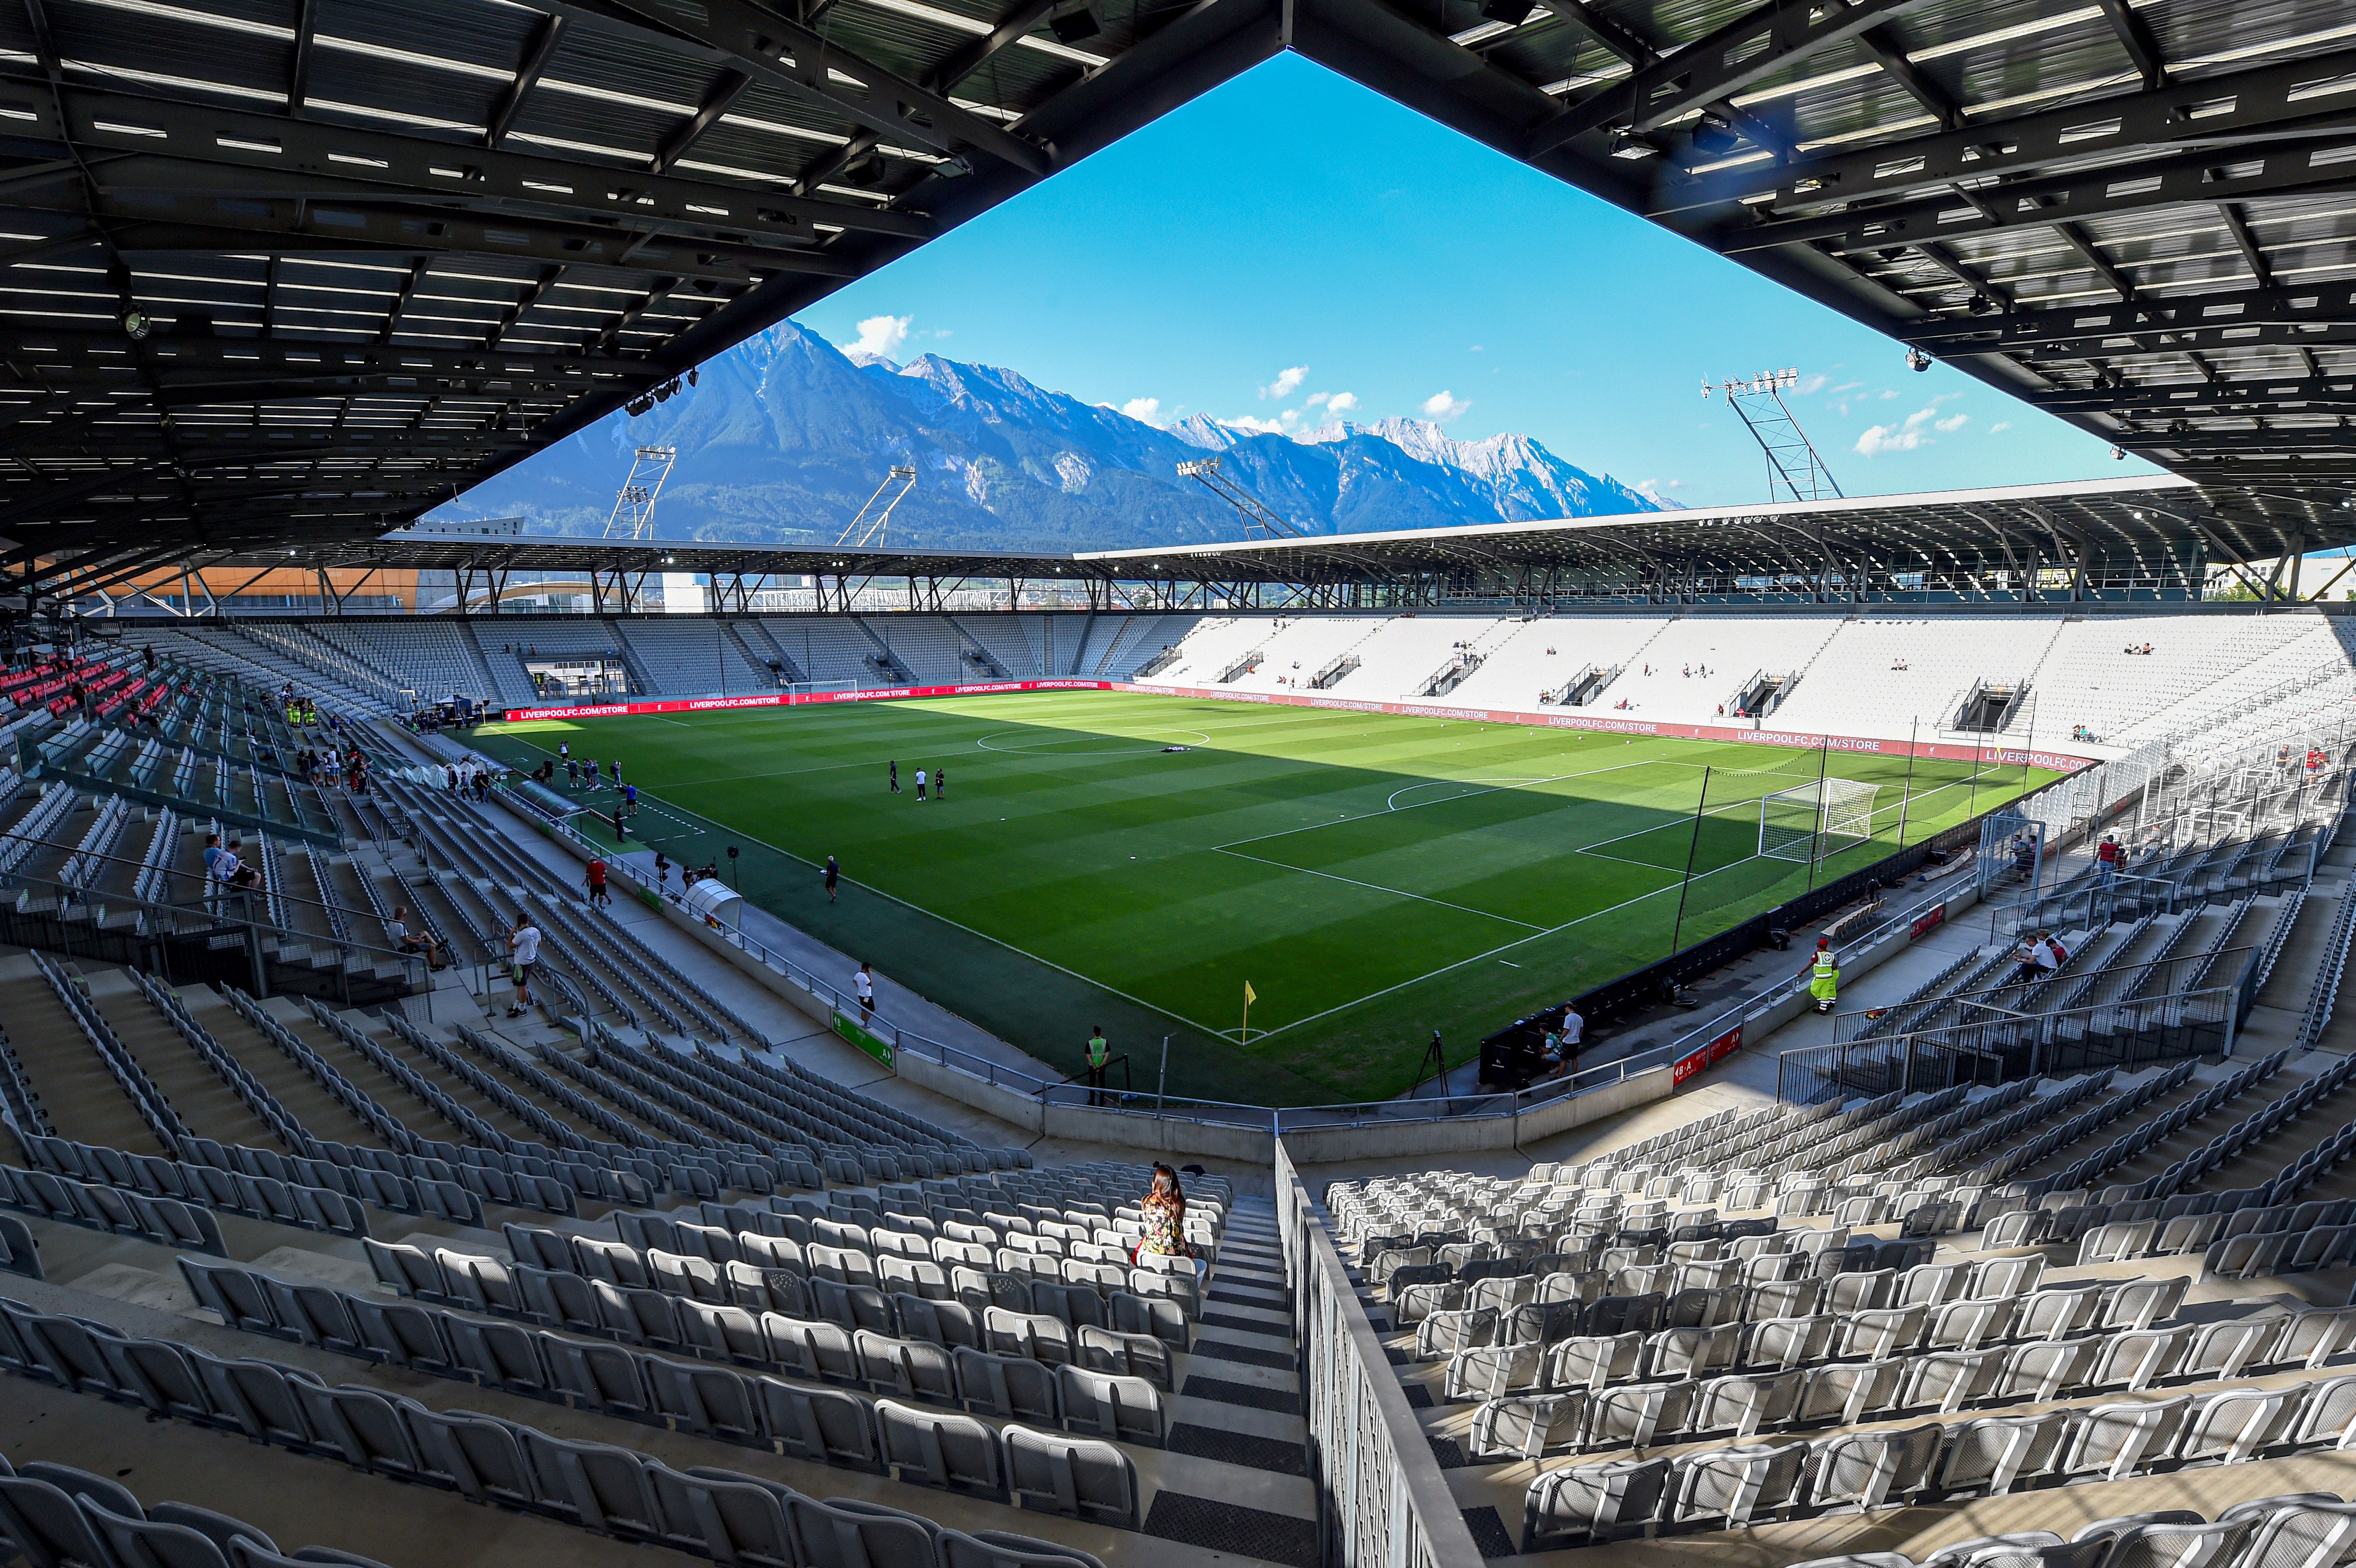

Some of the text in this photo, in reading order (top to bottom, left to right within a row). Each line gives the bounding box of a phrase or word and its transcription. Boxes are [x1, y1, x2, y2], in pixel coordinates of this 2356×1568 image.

[955, 683, 1021, 692] LIVERPOOLFC.COM/STORE
[1211, 691, 1269, 701] LIVERPOOLFC.COM/STORE
[690, 697, 779, 708] LIVERPOOLFC.COM/STORE
[1310, 699, 1383, 710] LIVERPOOLFC.COM/STORE
[521, 706, 628, 719] LIVERPOOLFC.COM/STORE
[1402, 706, 1488, 719] LIVERPOOLFC.COM/STORE
[1549, 717, 1656, 732] LIVERPOOLFC.COM/STORE
[1737, 731, 1879, 751] LIVERPOOLFC.COM/STORE
[1731, 1034, 1736, 1044] A
[882, 1048, 887, 1058] A
